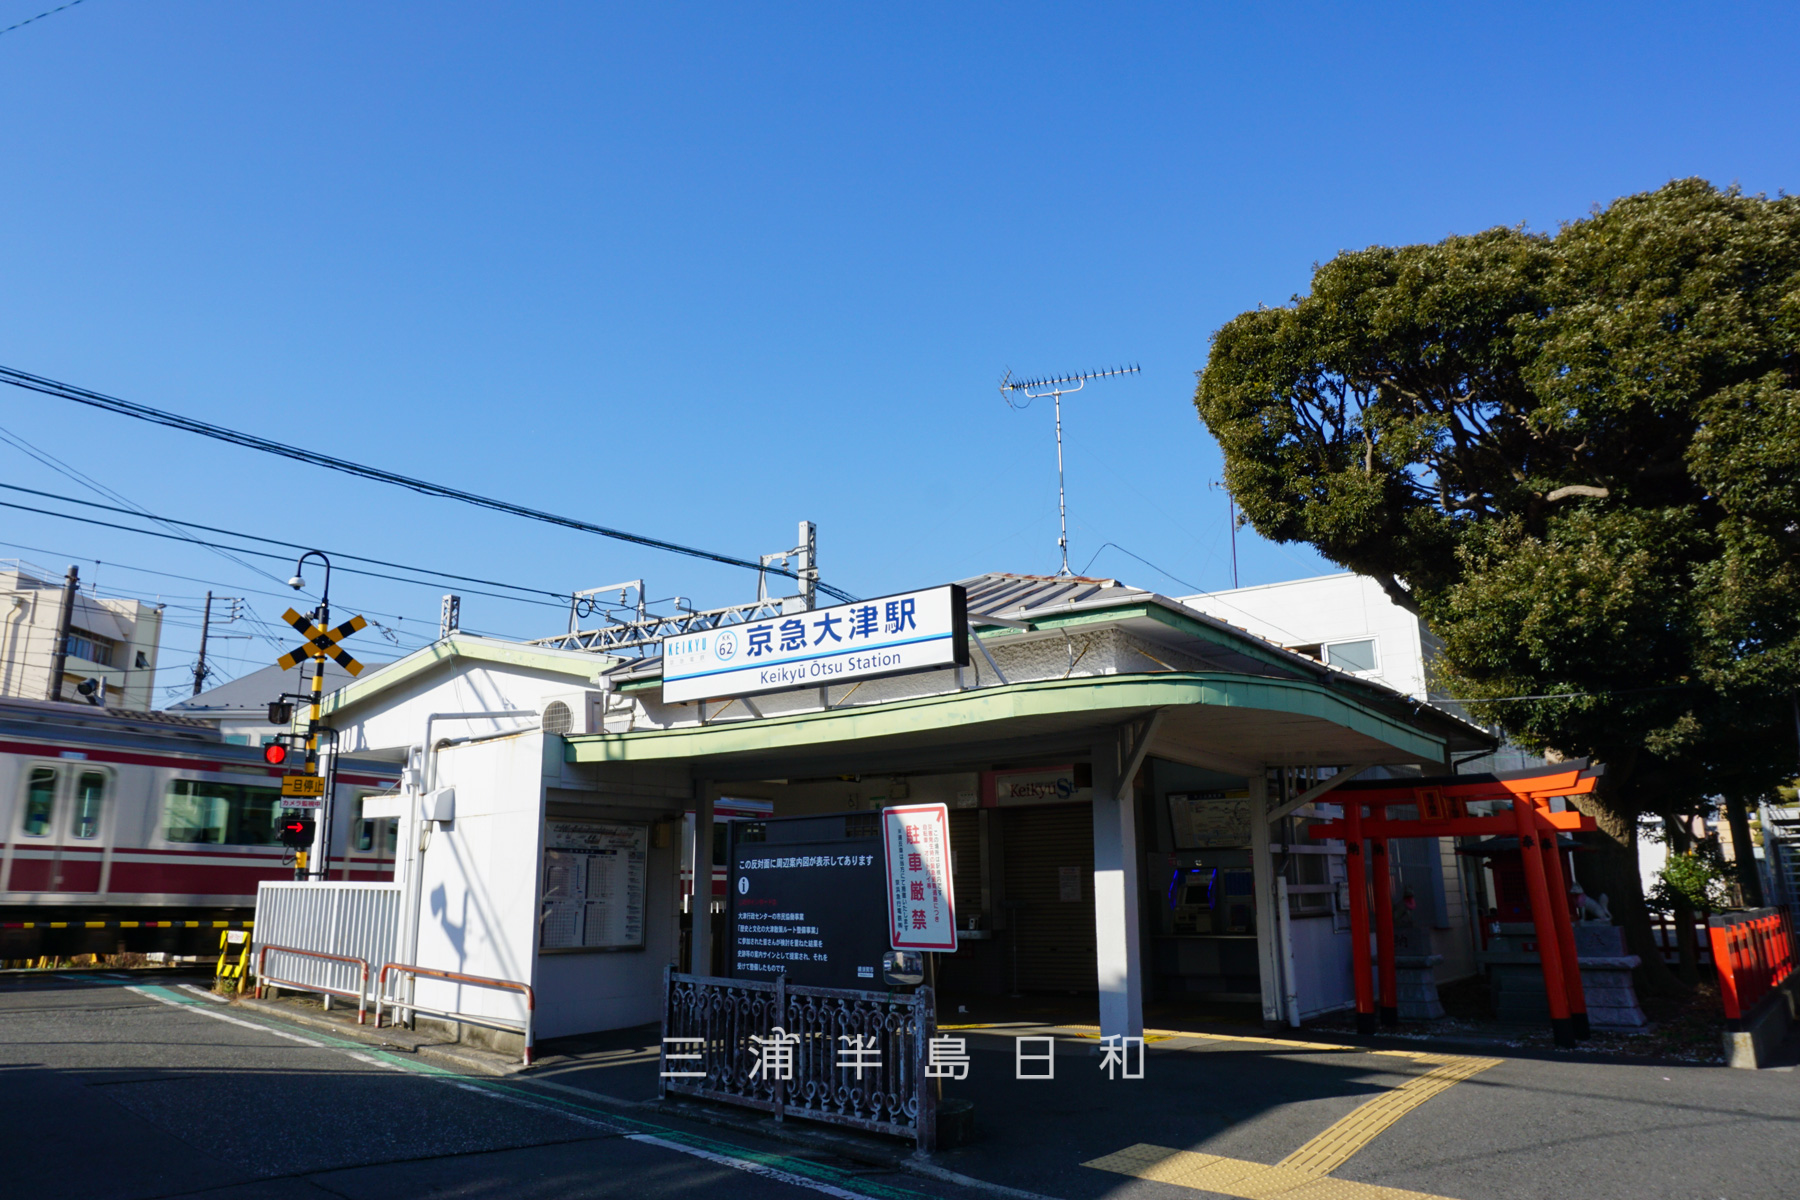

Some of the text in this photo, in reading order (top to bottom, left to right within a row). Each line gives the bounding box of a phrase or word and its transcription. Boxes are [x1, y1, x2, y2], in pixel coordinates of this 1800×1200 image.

[746, 597, 917, 657] 京急大津駅
[668, 637, 707, 657] KEIKYU
[719, 642, 733, 656] 62
[760, 652, 901, 685] Keikyū Ōtsu Station
[282, 779, 323, 793] 一旦停止
[1010, 783, 1056, 799] Keikyu
[739, 855, 873, 870] この反対面に周辺案内図が表示してあります
[906, 825, 927, 930] 駐車厳禁
